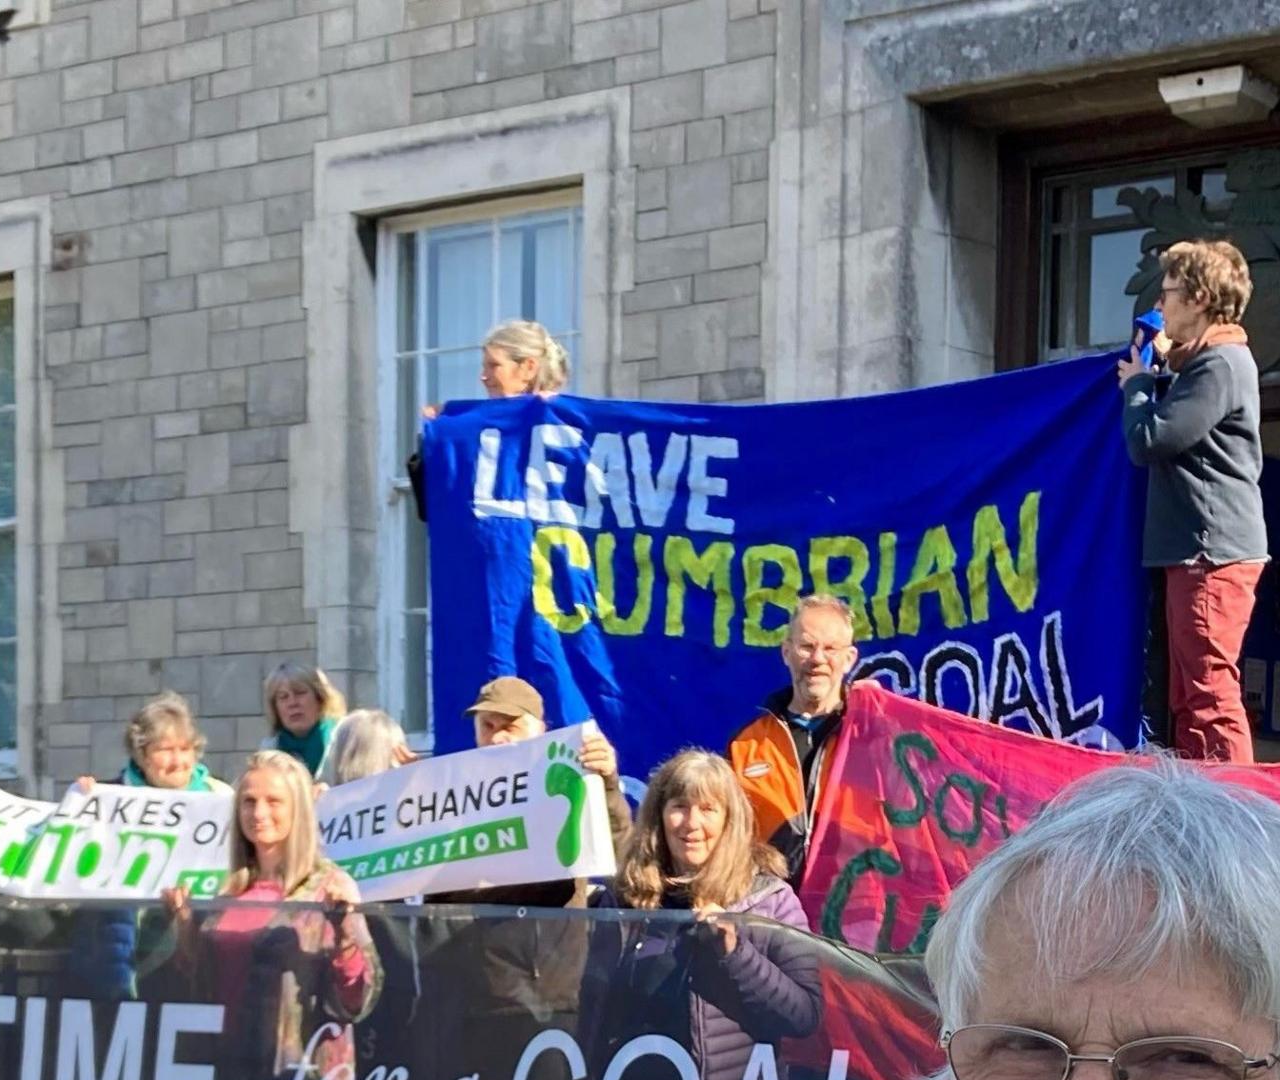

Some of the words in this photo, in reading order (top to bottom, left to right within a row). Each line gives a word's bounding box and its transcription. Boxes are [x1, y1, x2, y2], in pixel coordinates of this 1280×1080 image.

[473, 423, 740, 534] LEAVE
[532, 490, 1043, 649] CUMBRIAN
[396, 771, 529, 829] CHANGE
